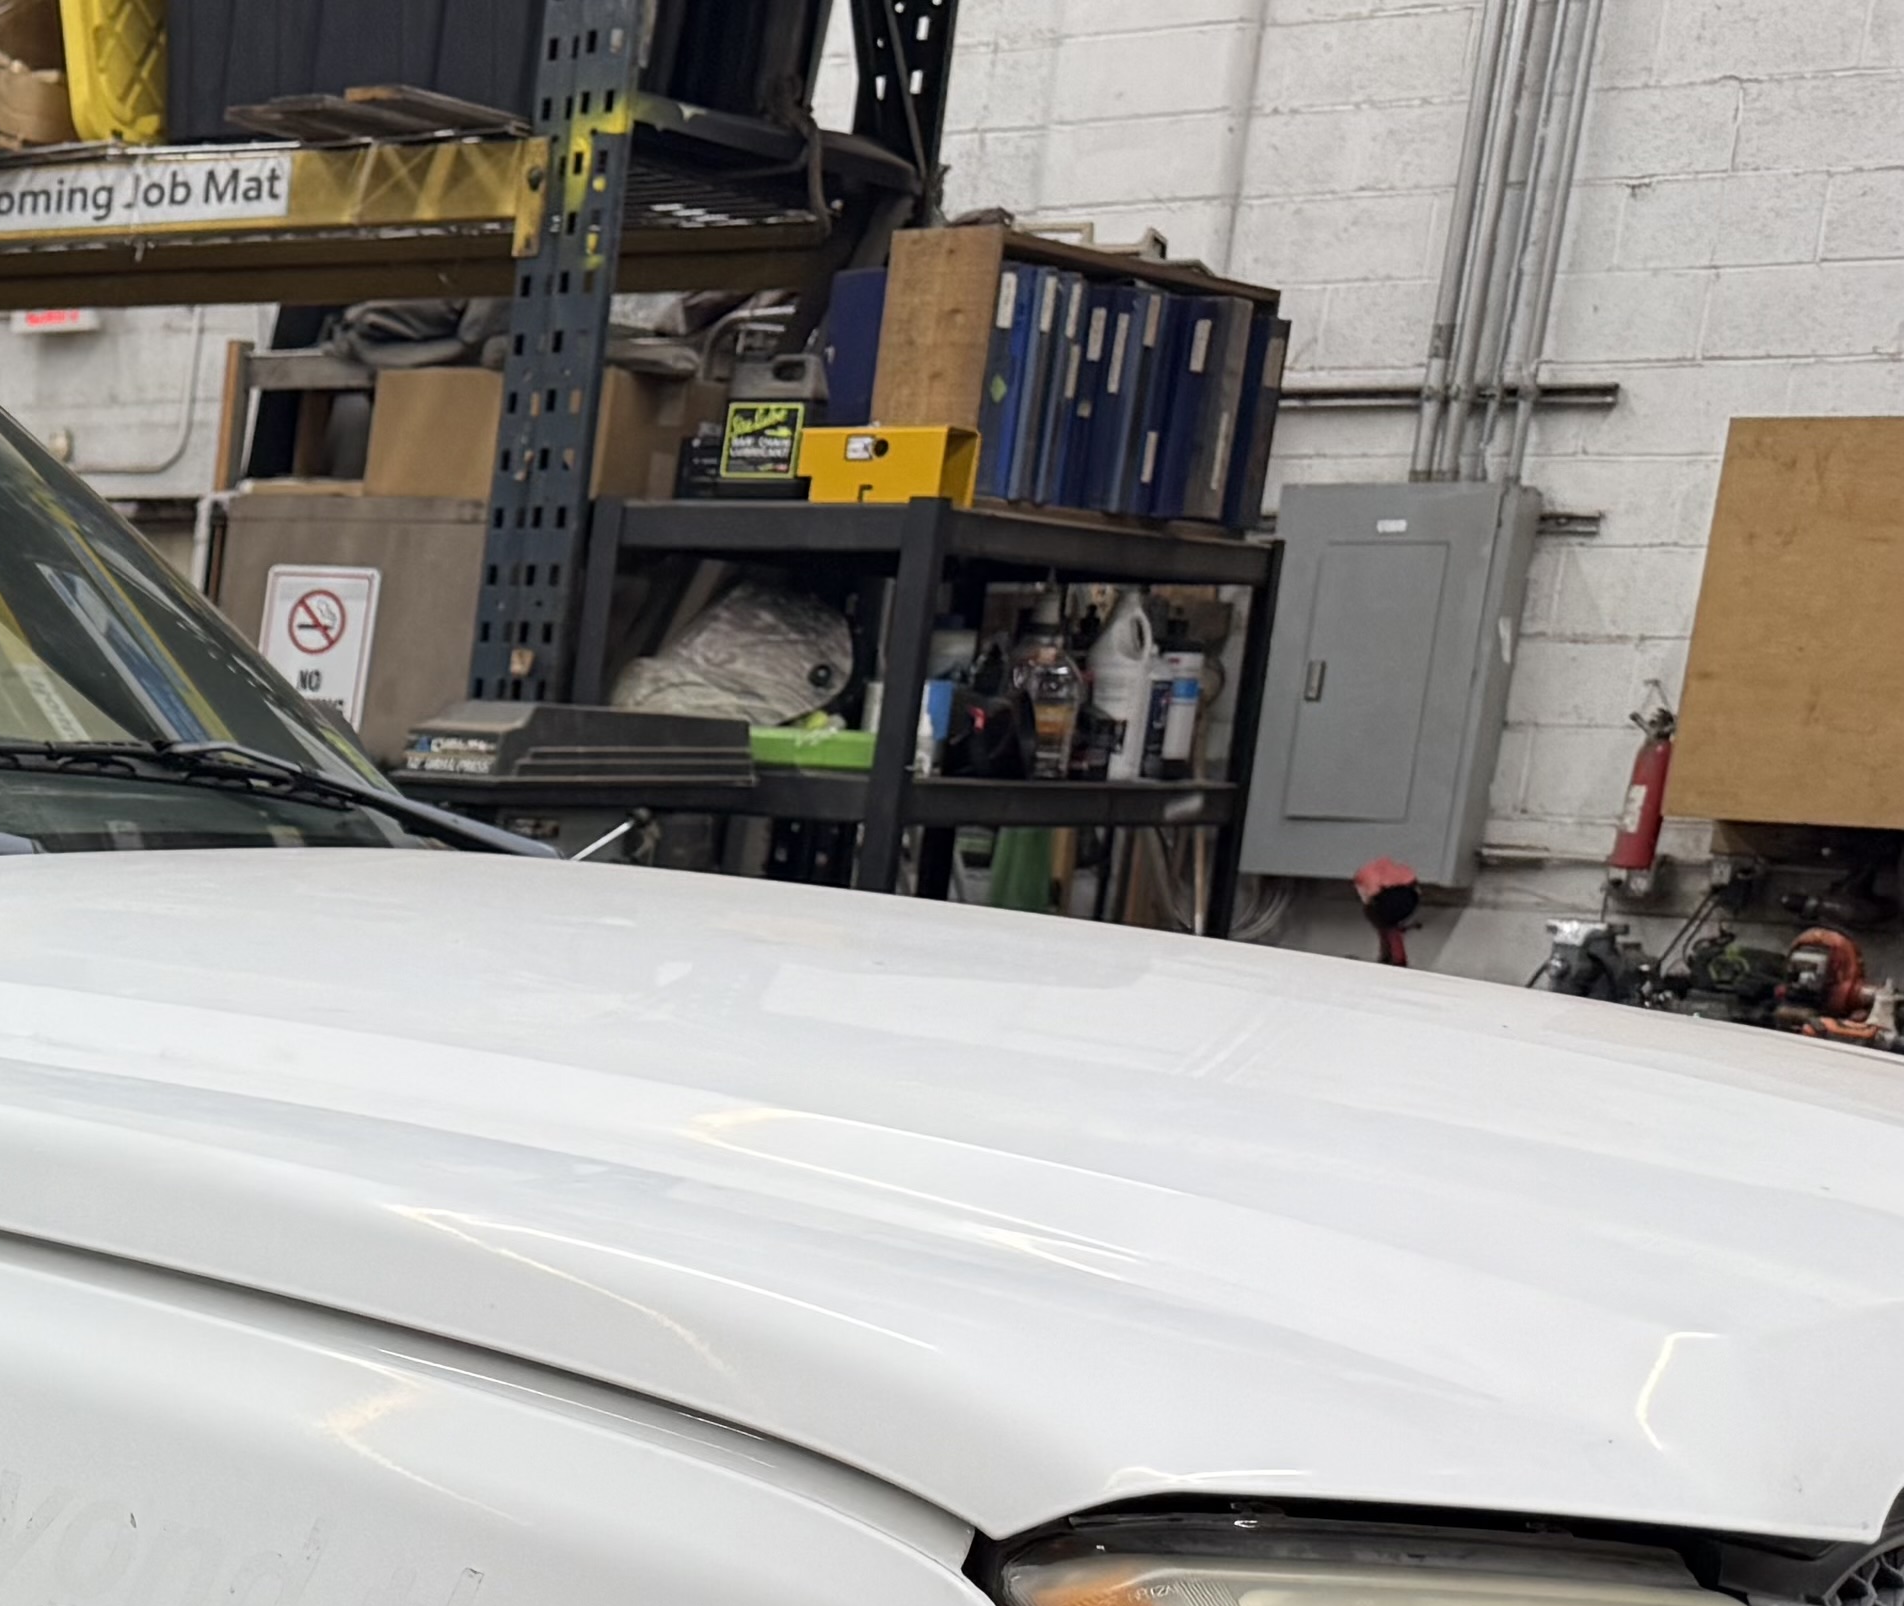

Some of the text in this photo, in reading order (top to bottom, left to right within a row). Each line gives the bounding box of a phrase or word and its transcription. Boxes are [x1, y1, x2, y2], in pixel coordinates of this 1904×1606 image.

[122, 170, 192, 210] Job
[202, 167, 282, 205] Mat
[297, 669, 322, 693] NO
